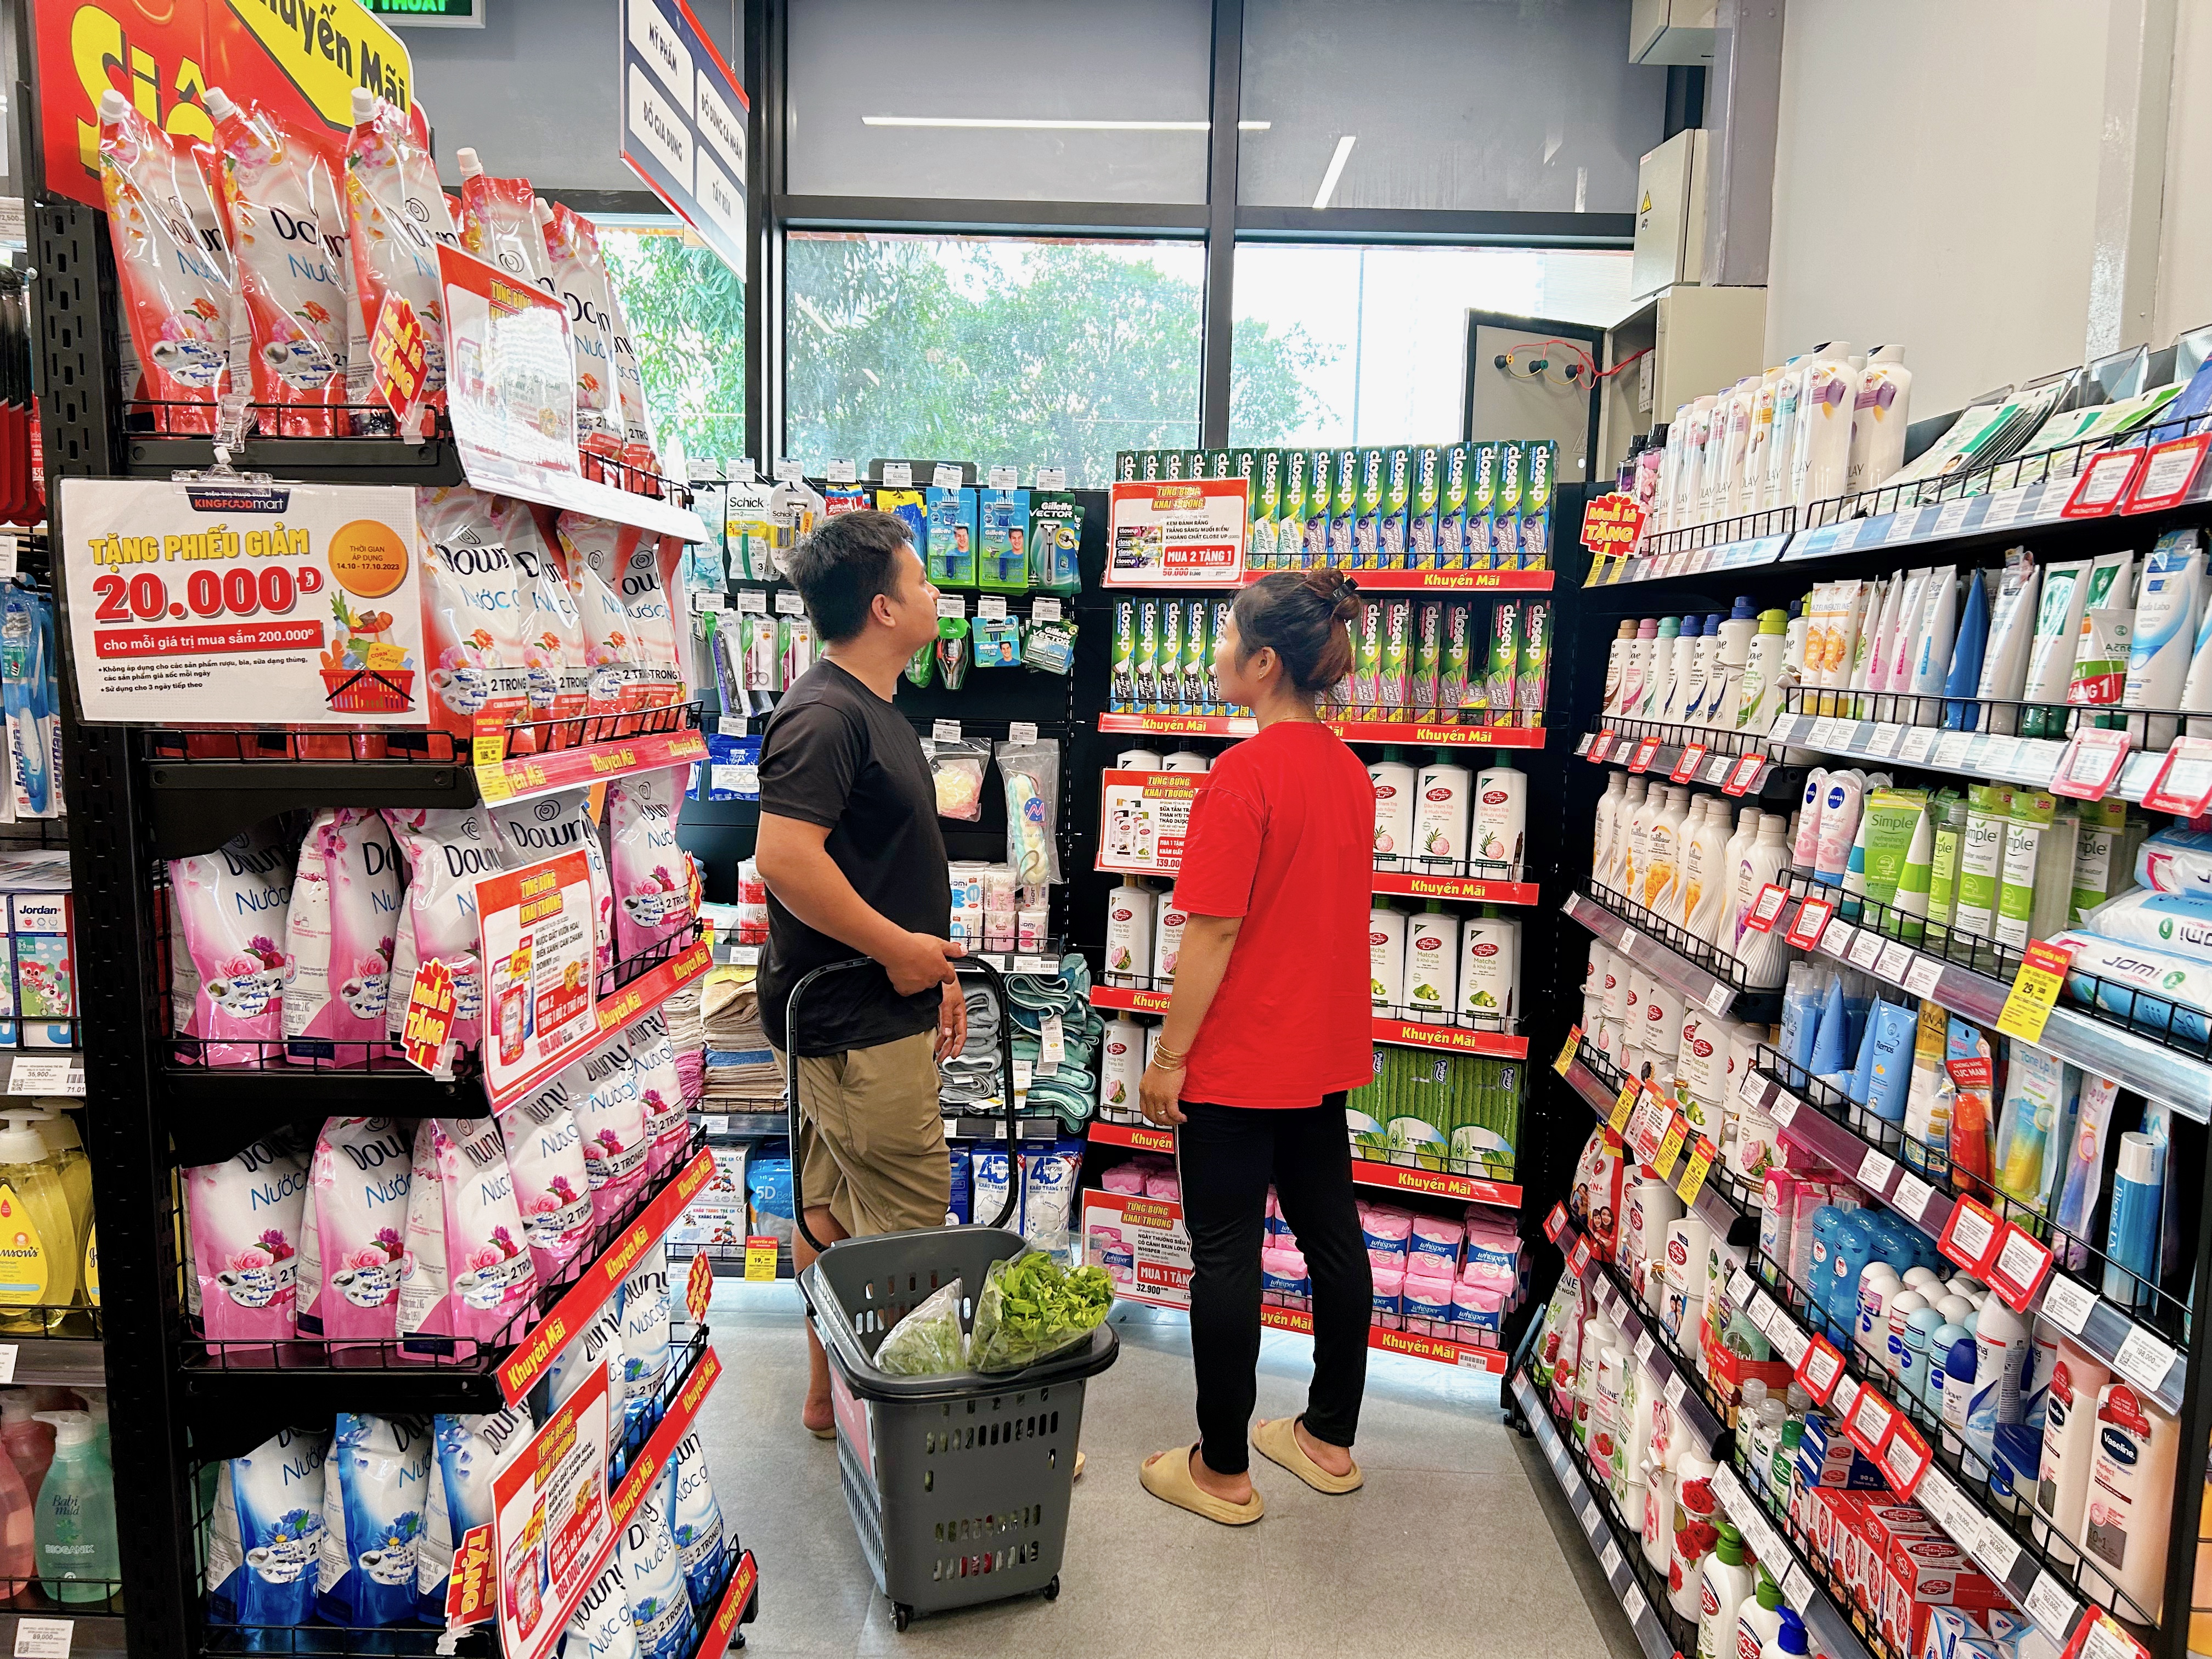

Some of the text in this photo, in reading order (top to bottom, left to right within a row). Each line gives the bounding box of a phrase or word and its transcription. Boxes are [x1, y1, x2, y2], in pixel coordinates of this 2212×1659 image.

[648, 20, 678, 76] MỸ PHẨM
[643, 99, 683, 163] ĐỒ GIA DỤNG
[701, 92, 743, 162] ĐỒ DÙNG CÁ NHÂN
[712, 179, 731, 218] TẨY RỬA
[373, 332, 416, 402] TẶNG
[1419, 449, 1437, 503] closeup
[195, 498, 284, 510] KINGFOODmart
[730, 496, 764, 509] Schick
[1041, 501, 1073, 511] Gillette
[2131, 499, 2171, 510] PROMOTION
[1029, 507, 1073, 518] VECTOR
[1589, 505, 1637, 522] Mua là
[1585, 524, 1634, 546] TẶNG
[88, 521, 309, 573] TẶNG PHIẾU GIẢM
[350, 544, 366, 552] THỜI
[1167, 551, 1187, 562] MUA
[1190, 551, 1197, 562] 2
[1227, 551, 1232, 561] 1
[1424, 572, 1500, 589] Khuyến Mãi
[1045, 626, 1072, 639] Gillette
[1118, 602, 1133, 652] closeup
[103, 639, 127, 652] cho
[131, 633, 154, 650] mỗi
[156, 635, 178, 652] giá
[180, 634, 195, 650] trị
[198, 634, 224, 646] mua
[228, 630, 255, 646] sắm
[1032, 629, 1070, 647] VECTOR
[103, 665, 125, 674] Không
[171, 662, 183, 670] các
[185, 661, 197, 669] sản
[199, 659, 217, 669] phẩm
[118, 673, 131, 681] sản
[132, 670, 151, 681] phẩm
[153, 672, 163, 680] giá
[165, 670, 178, 679] sốc
[179, 669, 192, 678] mỗi
[194, 670, 211, 678] ngày
[116, 685, 133, 693] dụng
[155, 683, 171, 691] ngày
[173, 681, 186, 690] tiếp
[491, 677, 527, 692] 2 TRONG
[1417, 729, 1492, 744] Khuyến Mãi
[1148, 776, 1190, 786] TƯNG BỪNG
[1871, 814, 1913, 830] Simple
[1874, 836, 1904, 845] refreshing
[1410, 879, 1486, 898] Khuyến Mãi
[20, 905, 58, 915] Jordan
[1417, 951, 1439, 960] Matcha
[408, 1008, 445, 1049] TẶNG
[1402, 1026, 1475, 1048] Khuyến Mãi
[1876, 1041, 1894, 1054] Remos
[755, 1186, 776, 1200] 5D
[1766, 1186, 1777, 1203] Veet
[1127, 1201, 1169, 1216] TƯNG BỪNG
[1123, 1214, 1172, 1228] KHAI TRƯƠNG
[1371, 1239, 1399, 1251] whisper
[1419, 1241, 1448, 1254] whisper
[1944, 1246, 1973, 1269] PROMOTION
[1136, 1283, 1160, 1295] 32.900
[1269, 1279, 1298, 1290] whisper
[2059, 1292, 2078, 1308] 249,000
[1459, 1310, 1488, 1322] whisper
[507, 1318, 567, 1392] Khuyến Mãi
[2136, 1347, 2155, 1364] 198,000
[1944, 1386, 1962, 1401] Dove
[2096, 1459, 2115, 1477] Perfect
[2096, 1468, 2111, 1482] Youth
[613, 1457, 655, 1524] Khuyến Mãi
[52, 1496, 78, 1508] Babi
[55, 1506, 80, 1516] mild
[526, 1514, 543, 1543] 42%
[46, 1544, 94, 1555] BIOGANIK
[1912, 1545, 1956, 1556] Lifebuoy
[556, 1560, 580, 1604] 109.000
[1921, 1582, 1951, 1592] Lifebuoy
[2041, 1592, 2058, 1612] 150,000
[33, 1633, 54, 1641] 89,000
